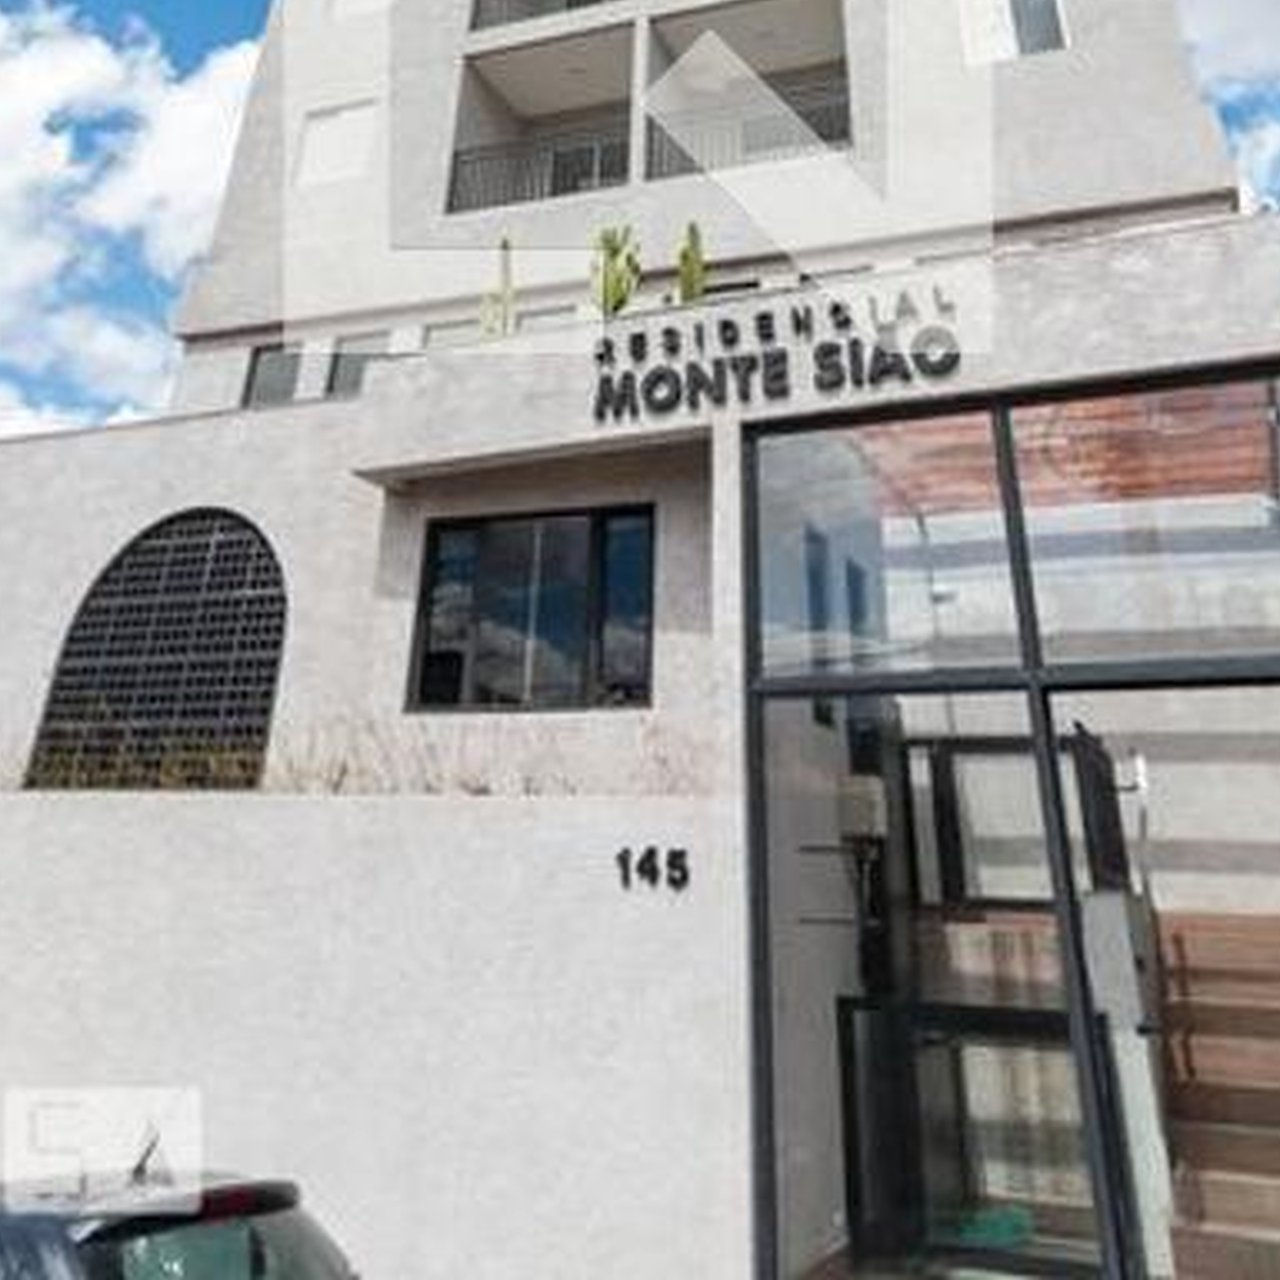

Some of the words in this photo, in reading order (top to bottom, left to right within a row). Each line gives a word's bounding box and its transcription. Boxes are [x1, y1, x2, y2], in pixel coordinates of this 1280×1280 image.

[594, 283, 956, 366] RESIDENCIAL
[594, 346, 789, 422] MONTE
[617, 845, 689, 891] 145
